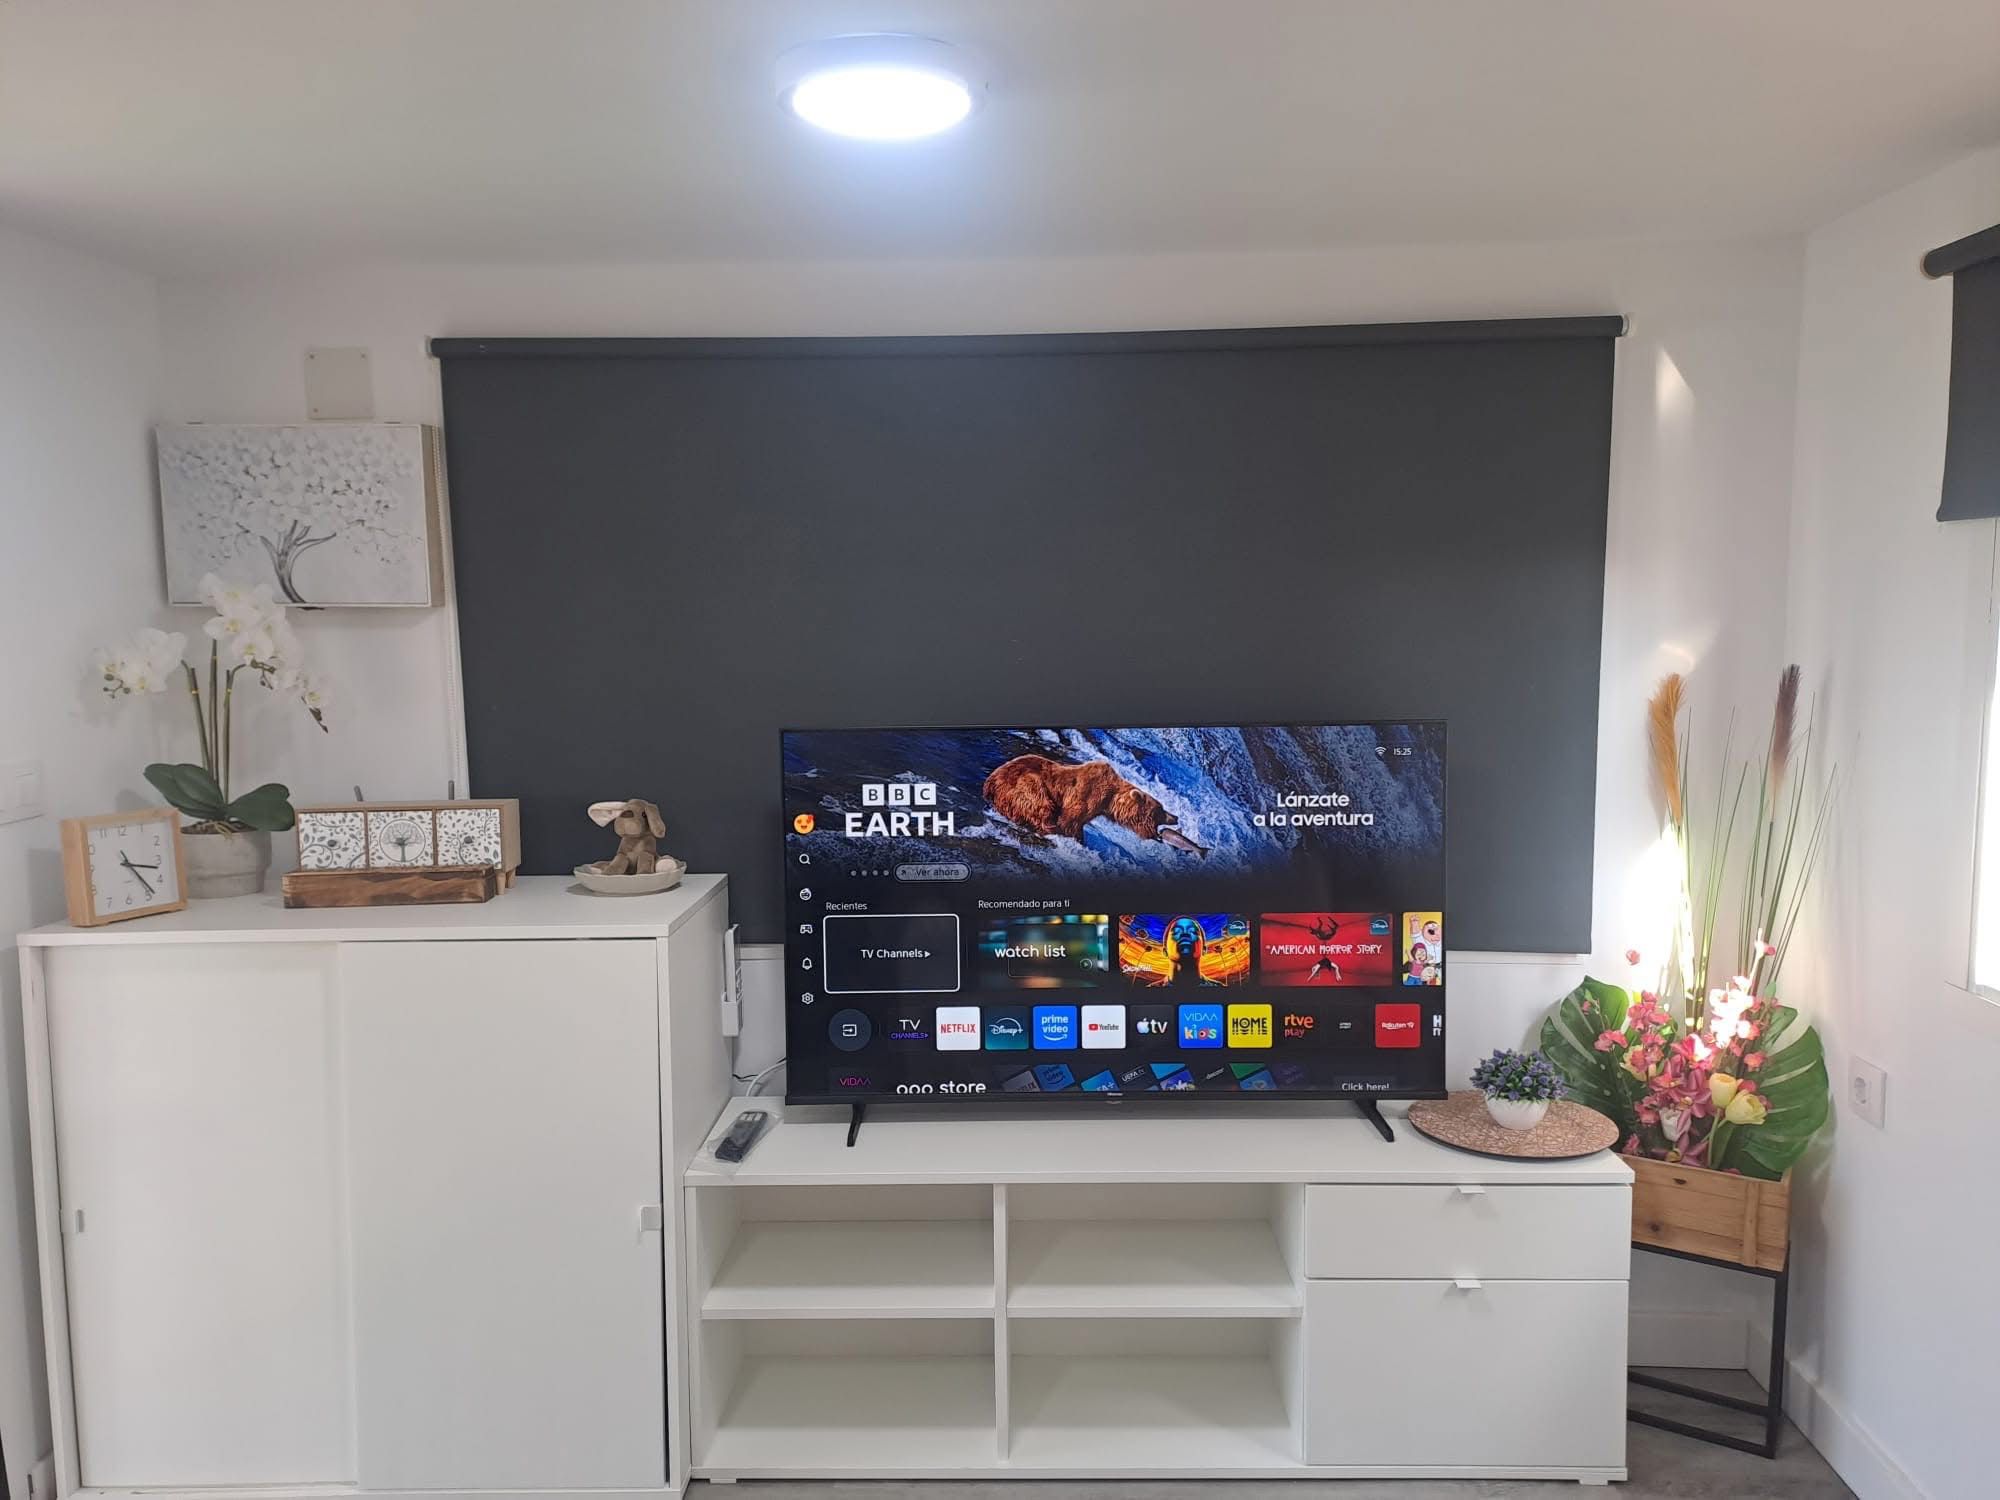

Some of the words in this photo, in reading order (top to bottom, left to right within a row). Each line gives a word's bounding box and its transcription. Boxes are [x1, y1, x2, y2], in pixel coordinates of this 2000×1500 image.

[1393, 747, 1413, 756] 15:25
[864, 785, 935, 804] BBC
[1276, 791, 1350, 808] Lánzate
[845, 811, 955, 838] EARTH
[1253, 814, 1266, 827] a
[1269, 811, 1287, 827] la
[1290, 811, 1374, 827] aventura
[915, 868, 931, 876] Ver
[932, 867, 960, 876] ahora
[825, 901, 868, 911] Recientes
[978, 899, 1041, 909] Recomendado
[1042, 900, 1062, 910] para
[860, 949, 875, 959] TV
[876, 948, 923, 959] Channels
[994, 944, 1040, 958] watch
[1043, 944, 1067, 958] list
[1270, 944, 1316, 955] AMERICAN
[1319, 944, 1353, 955] HORROR
[1356, 944, 1383, 955] STORY
[1041, 1014, 1069, 1026] prime
[1183, 1012, 1218, 1022] VIDAA
[1284, 1013, 1314, 1029] rtve
[898, 1018, 921, 1031] TV
[940, 1022, 976, 1034] NETFLIX
[989, 1020, 1024, 1037] Disney+
[1042, 1025, 1069, 1034] video
[1099, 1023, 1120, 1032] YouTube
[1150, 1018, 1168, 1034] tv
[1232, 1017, 1268, 1031] HOME
[1381, 1021, 1407, 1030] Rakuten
[1184, 1024, 1218, 1041] kids
[1284, 1027, 1305, 1038] play
[839, 1076, 872, 1087] VIDAA
[939, 1080, 987, 1094] store
[1341, 1082, 1364, 1091] Click
[1366, 1082, 1390, 1091] here!
